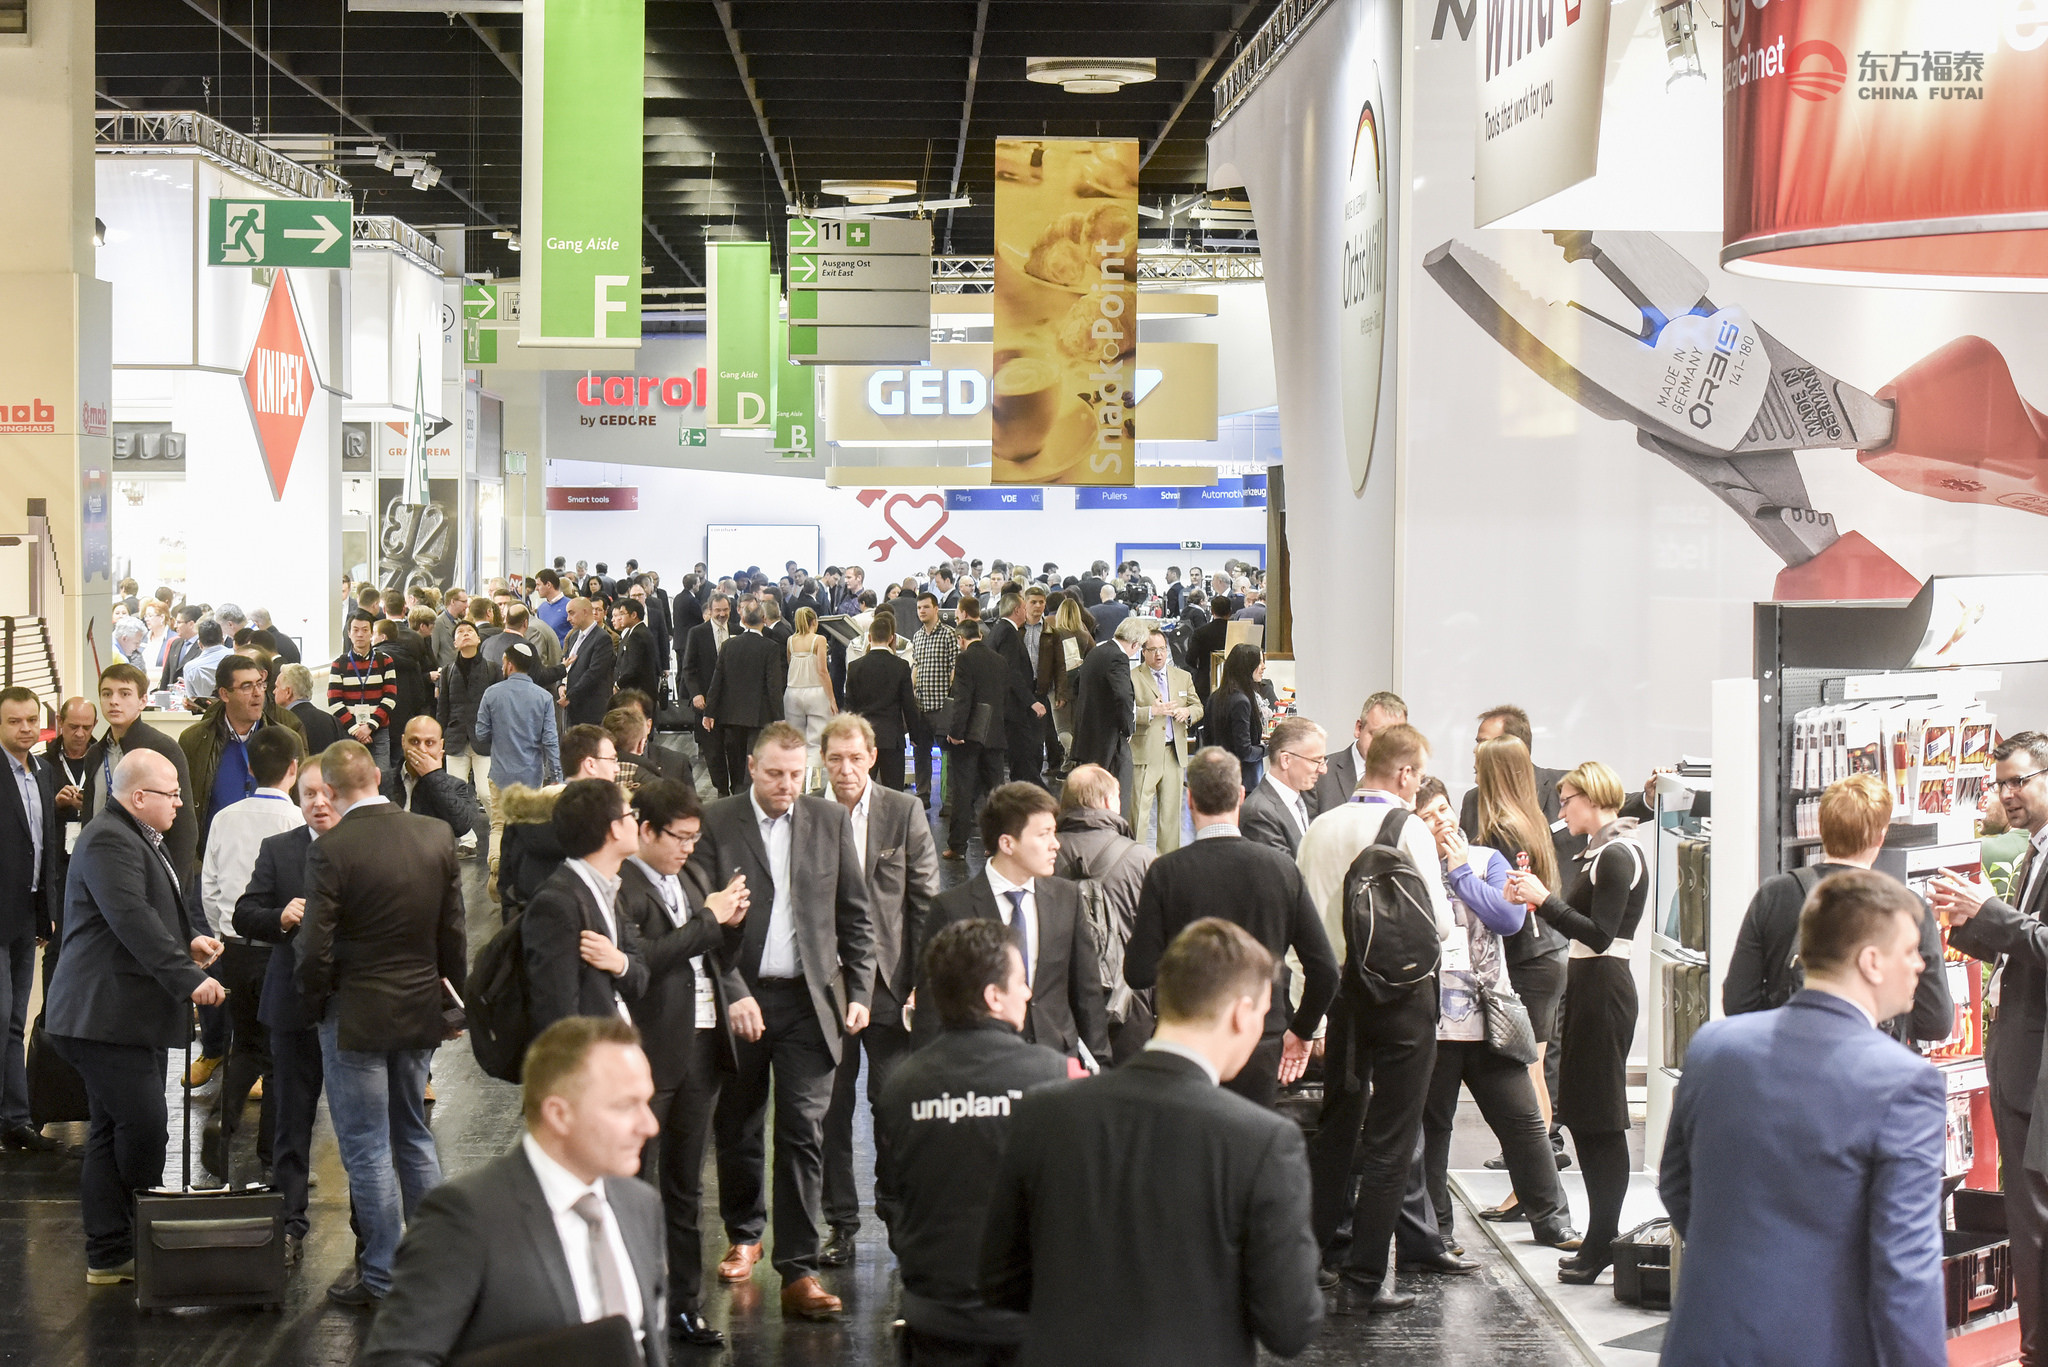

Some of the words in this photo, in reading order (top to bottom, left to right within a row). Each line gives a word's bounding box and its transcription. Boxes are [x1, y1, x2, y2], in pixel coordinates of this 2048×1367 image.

[1485, 111, 1501, 142] Tools
[1501, 98, 1513, 133] that
[1513, 87, 1529, 126] work
[1530, 83, 1540, 116] for
[1541, 80, 1554, 119] you
[546, 237, 583, 253] Gang
[586, 237, 619, 250] Aisle
[821, 222, 841, 240] 11
[822, 260, 855, 268] Ausgang
[594, 275, 630, 338] F
[1091, 238, 1125, 340] Point
[257, 347, 303, 417] KNIPEX
[720, 371, 739, 380] Gang
[741, 371, 758, 379] Aisle
[868, 369, 992, 415] GED
[1657, 365, 1681, 408] MADE
[1673, 347, 1687, 363] IN
[1671, 346, 1704, 415] GERMANY
[1688, 320, 1739, 430] ORBIS
[1780, 366, 1802, 388] IN
[580, 415, 596, 428] by
[600, 414, 657, 426] GEDORE
[737, 391, 766, 425] D
[1089, 358, 1124, 475] Snack
[1791, 387, 1823, 438] MADE
[1797, 365, 1843, 441] GERMANY
[791, 425, 807, 449] B
[567, 495, 590, 503] Smart
[1001, 494, 1017, 503] VDE
[1102, 491, 1127, 500] Pullers
